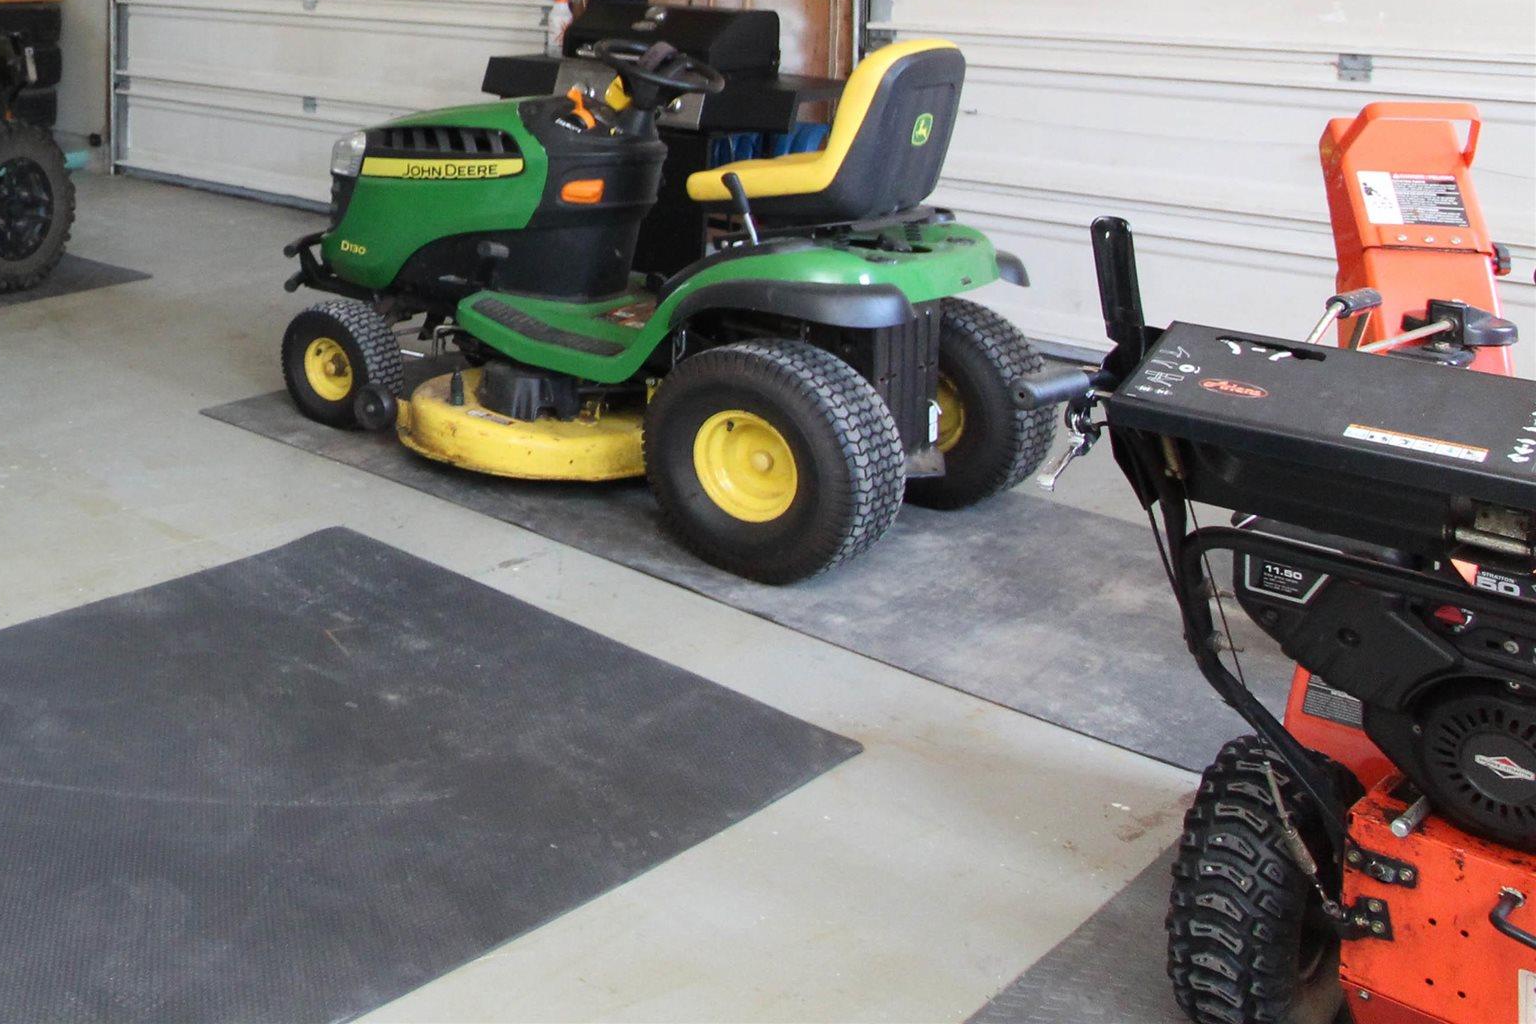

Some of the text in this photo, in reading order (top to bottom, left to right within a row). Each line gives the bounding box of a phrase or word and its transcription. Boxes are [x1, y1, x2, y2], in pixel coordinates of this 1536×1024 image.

[402, 163, 498, 178] JOHN DEERE
[341, 240, 367, 256] D130
[1264, 564, 1303, 581] 11.50
